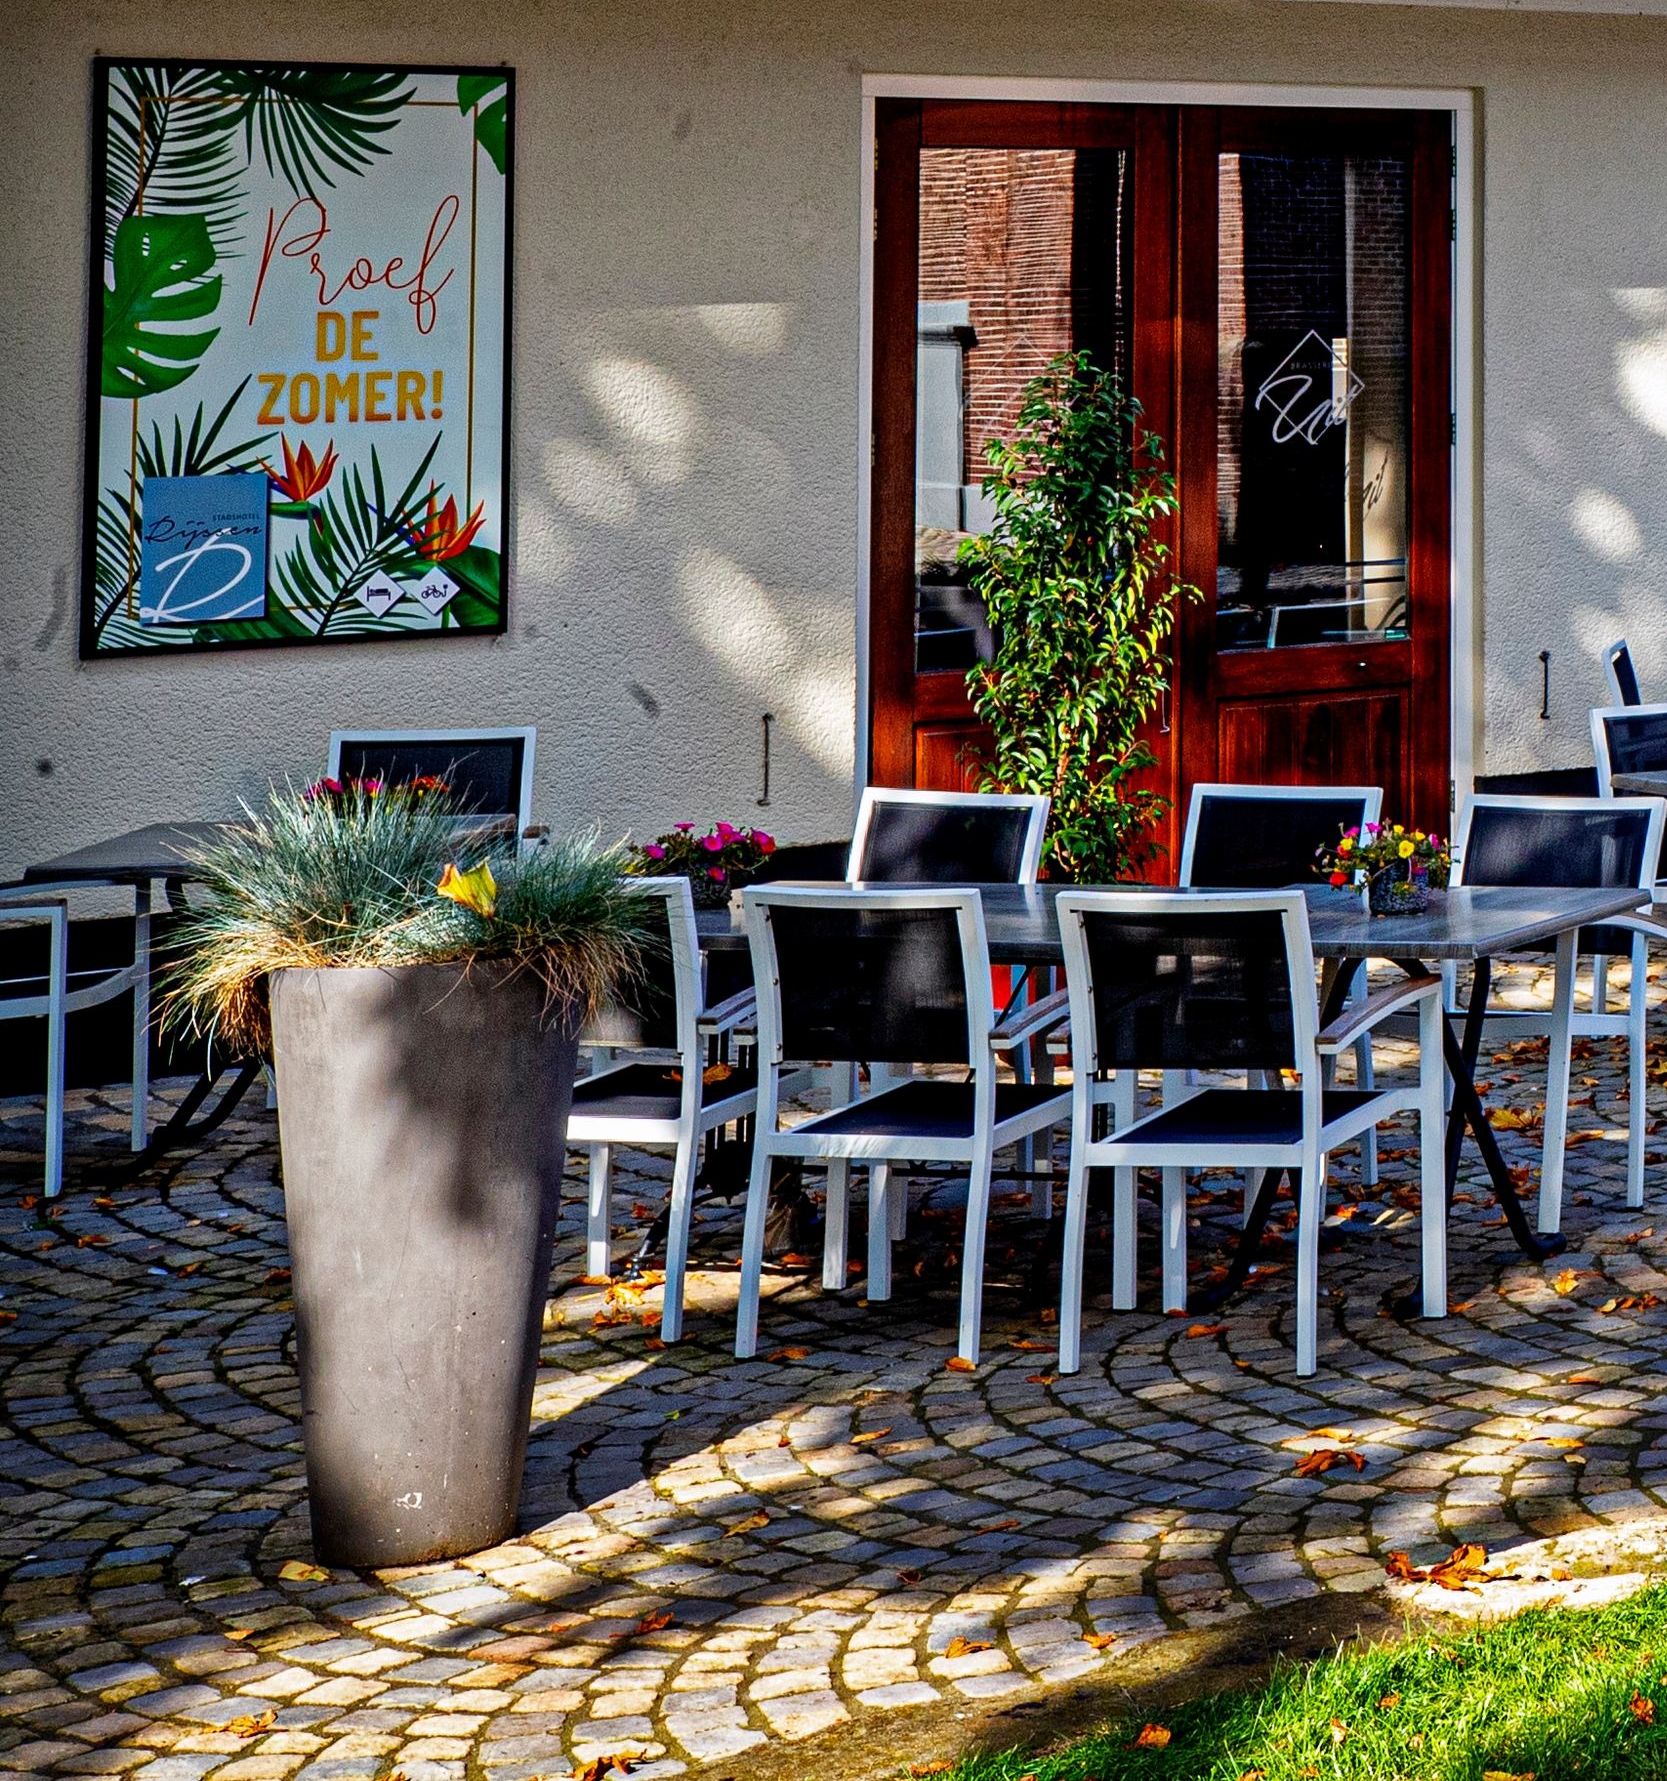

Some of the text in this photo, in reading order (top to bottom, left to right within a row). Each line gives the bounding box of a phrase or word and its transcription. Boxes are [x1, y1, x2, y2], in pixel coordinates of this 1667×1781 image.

[249, 193, 460, 335] Proef
[314, 310, 380, 363] DE
[256, 369, 444, 427] ZOMER!
[144, 515, 263, 550] Rijssen
[212, 513, 260, 522] STADSHOTEL
